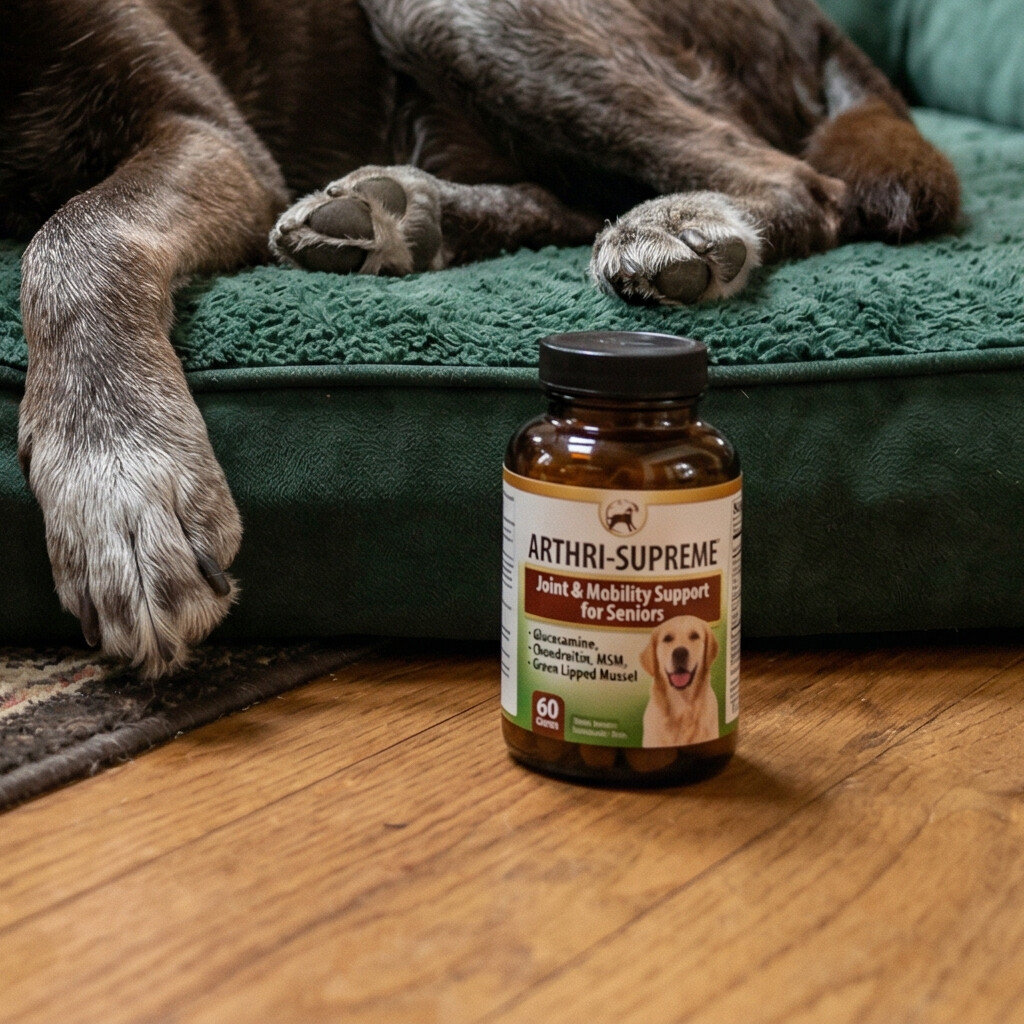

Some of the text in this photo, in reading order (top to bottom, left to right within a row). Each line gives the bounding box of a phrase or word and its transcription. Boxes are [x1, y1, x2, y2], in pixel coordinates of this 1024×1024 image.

[528, 533, 718, 571] ARTHRI-SUPREME
[536, 575, 710, 607] Joint & Mobility Support
[580, 601, 665, 623] for Seniors
[561, 664, 597, 681] Lipped
[599, 668, 638, 682] Mussel
[536, 697, 559, 720] 60
